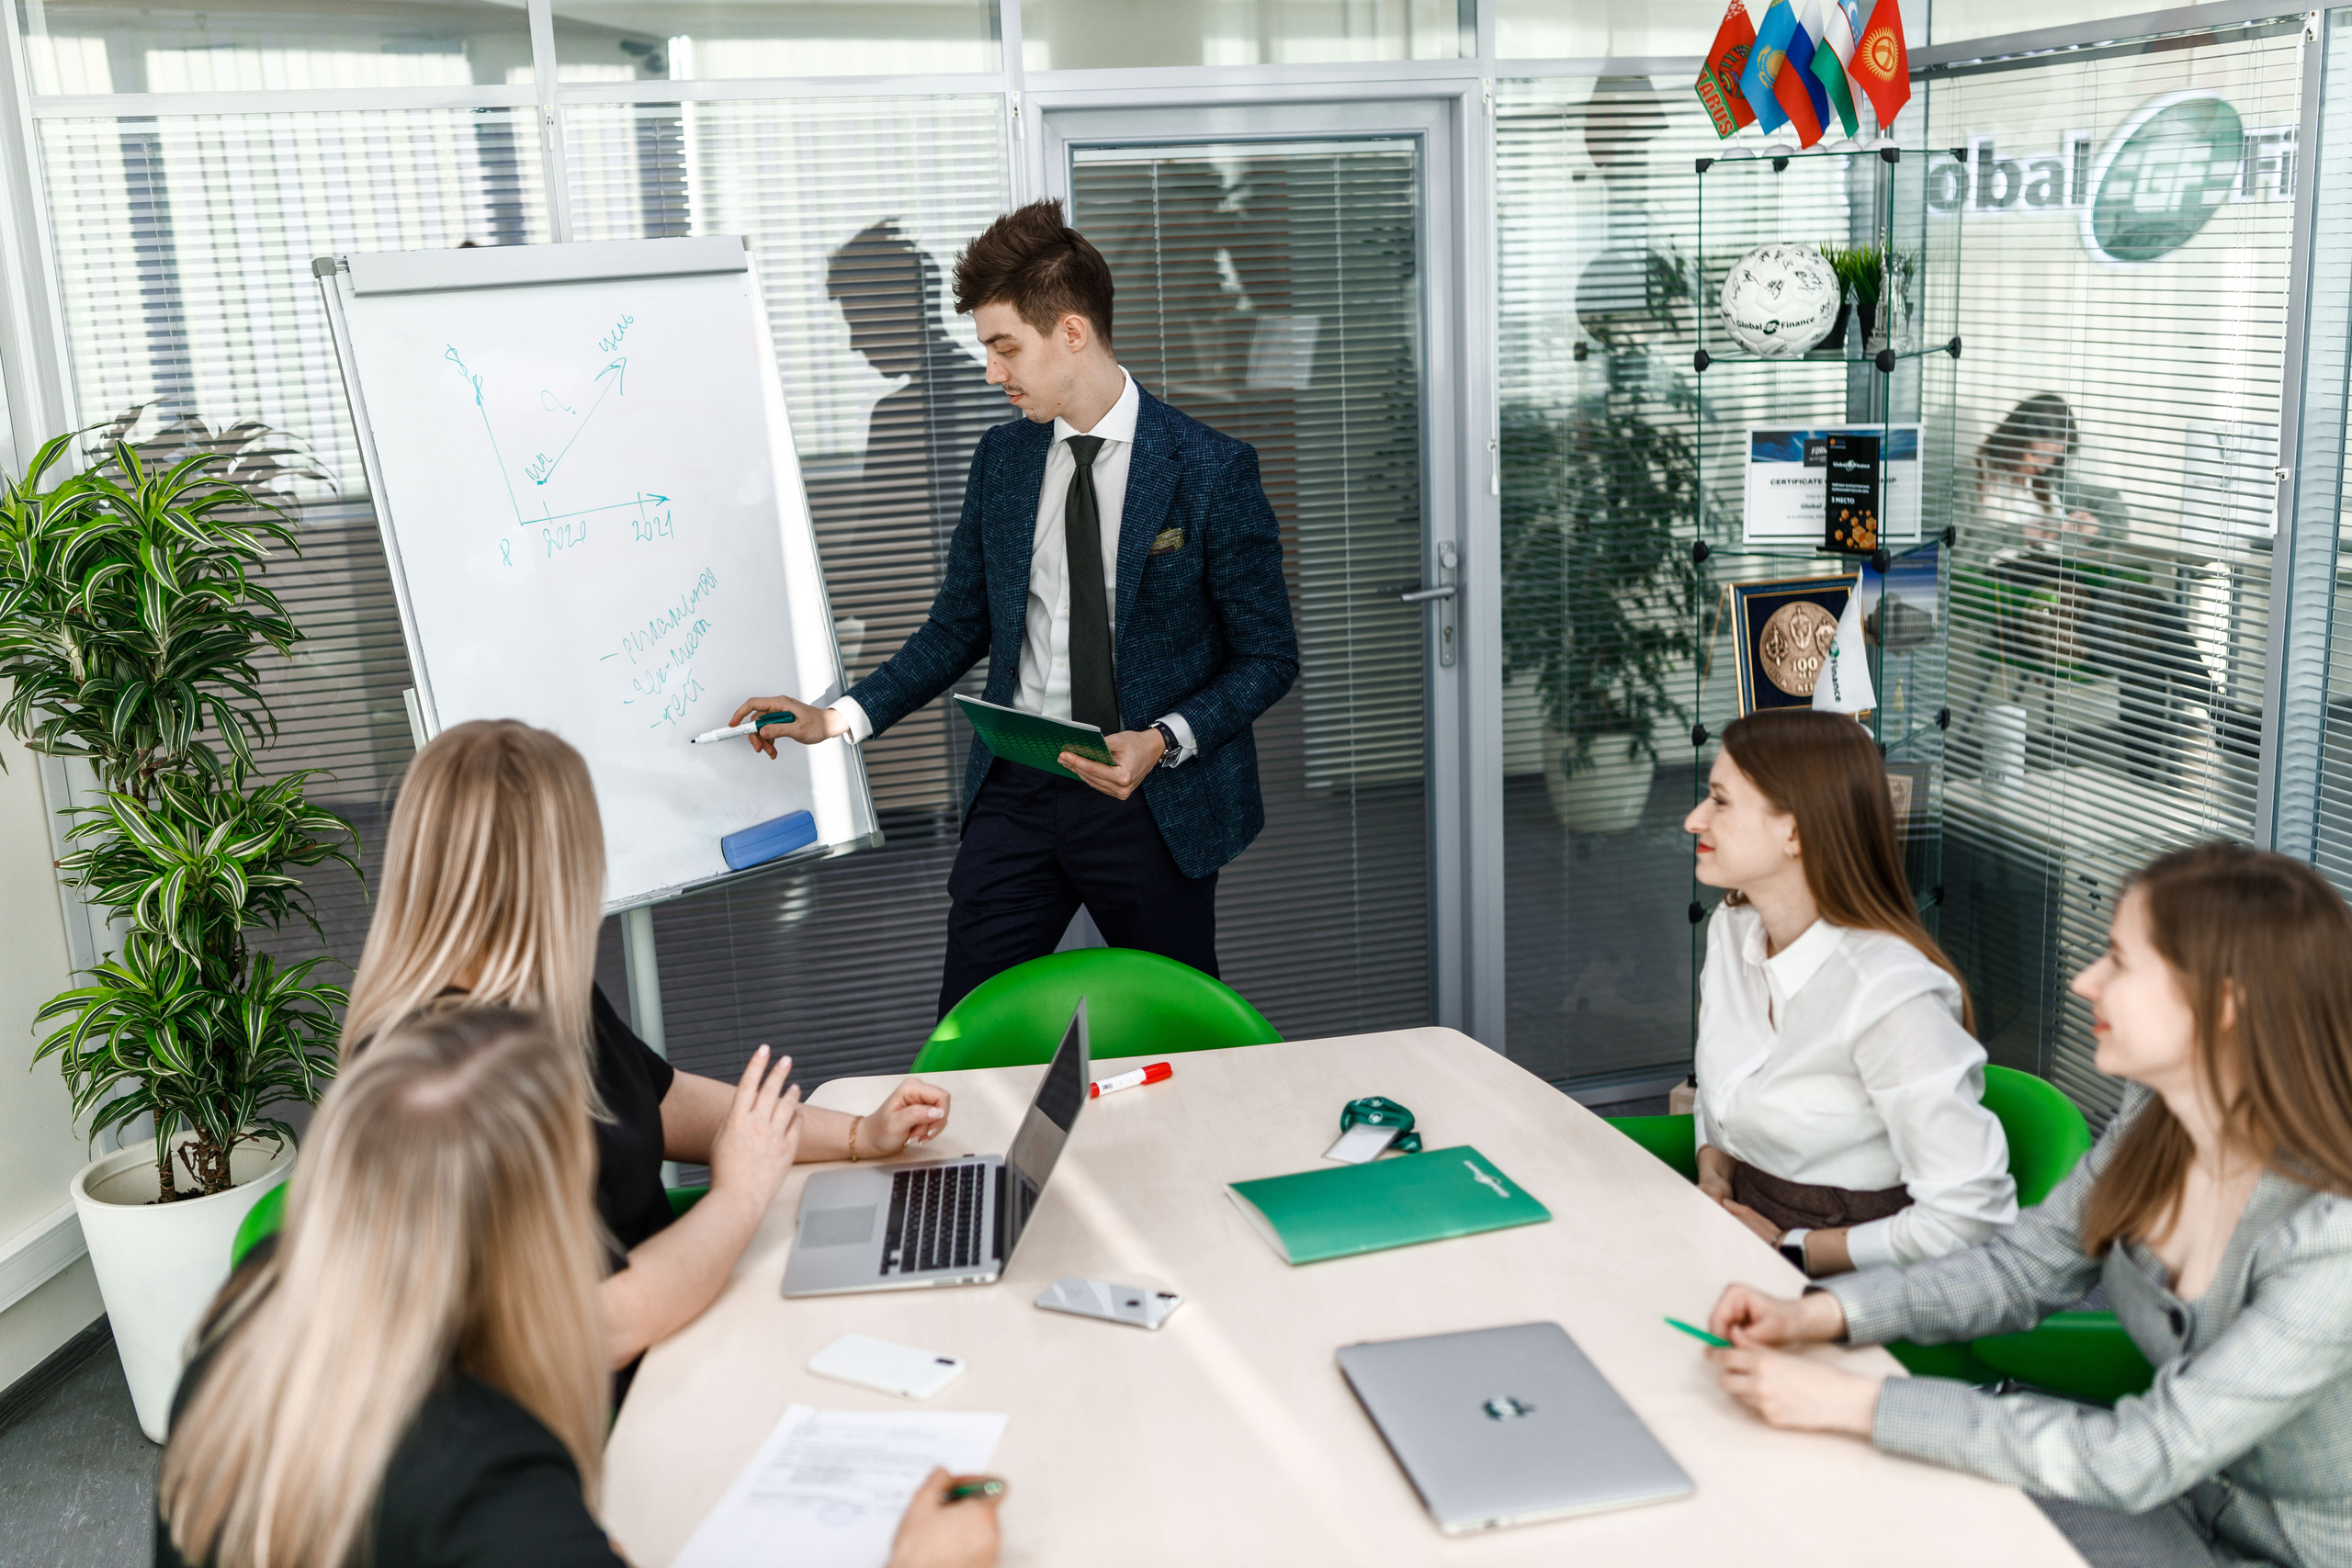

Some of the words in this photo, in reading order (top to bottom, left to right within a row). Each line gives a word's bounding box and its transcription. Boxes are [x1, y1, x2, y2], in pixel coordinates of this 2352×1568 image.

[1696, 67, 1735, 136] LARUS
[1736, 319, 1762, 331] Global
[1781, 316, 1815, 330] Finance
[1770, 478, 1824, 486] CERTIFICATE
[632, 509, 674, 542] 2021
[1831, 659, 1842, 704] Finance
